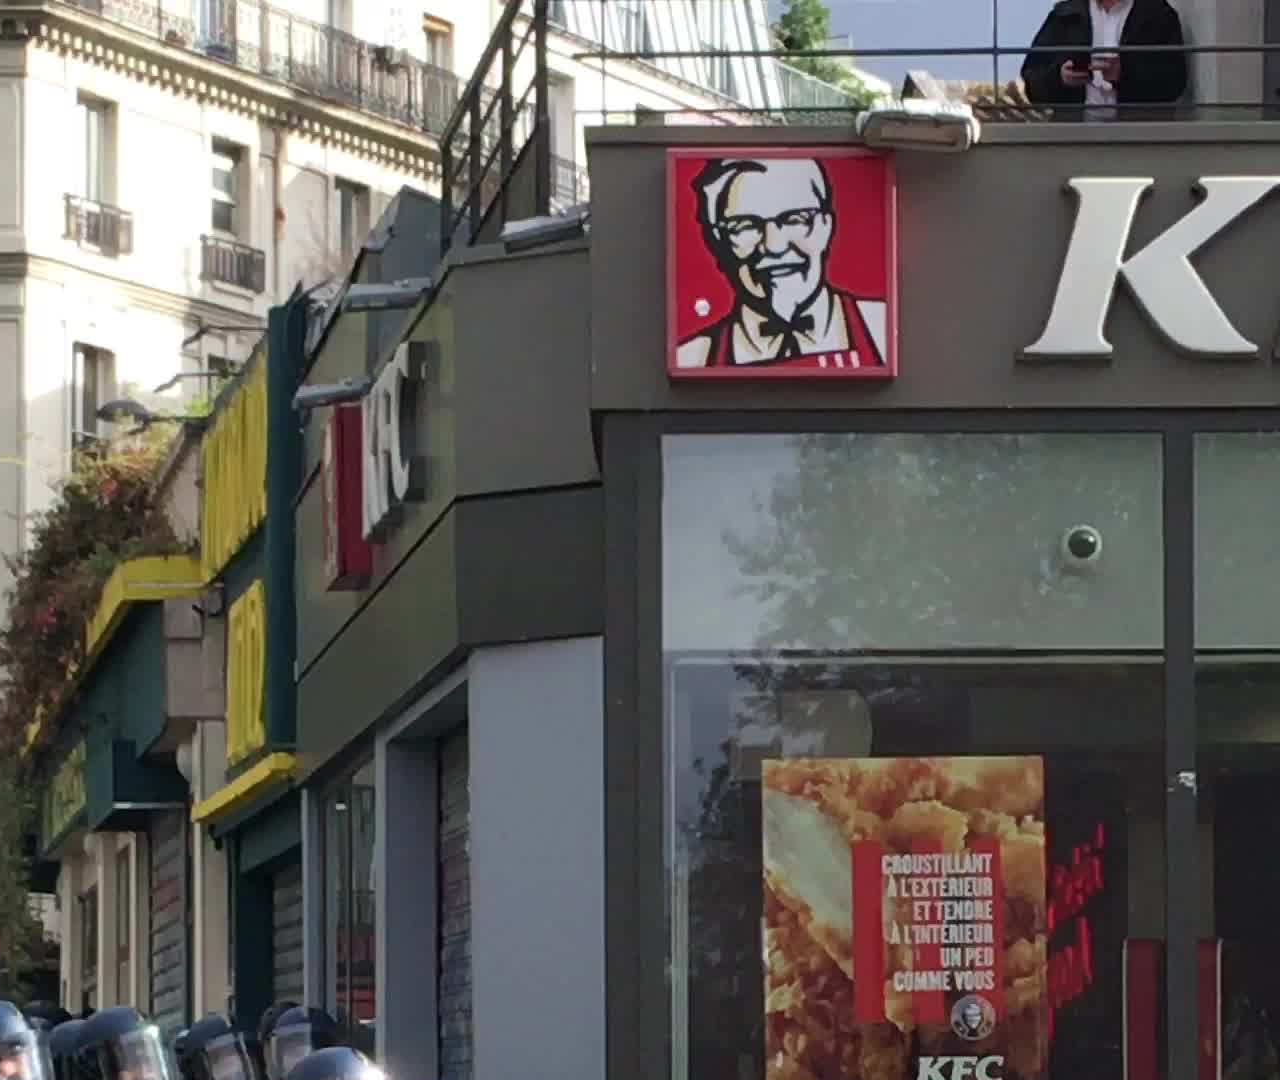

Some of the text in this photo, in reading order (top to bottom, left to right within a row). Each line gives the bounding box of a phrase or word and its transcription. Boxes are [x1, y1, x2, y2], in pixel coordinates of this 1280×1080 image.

[881, 853, 992, 874] CROUSTILLANT
[914, 900, 992, 920] ET TENDRE
[940, 947, 993, 966] UN PEU
[894, 970, 995, 991] COMME VOUS
